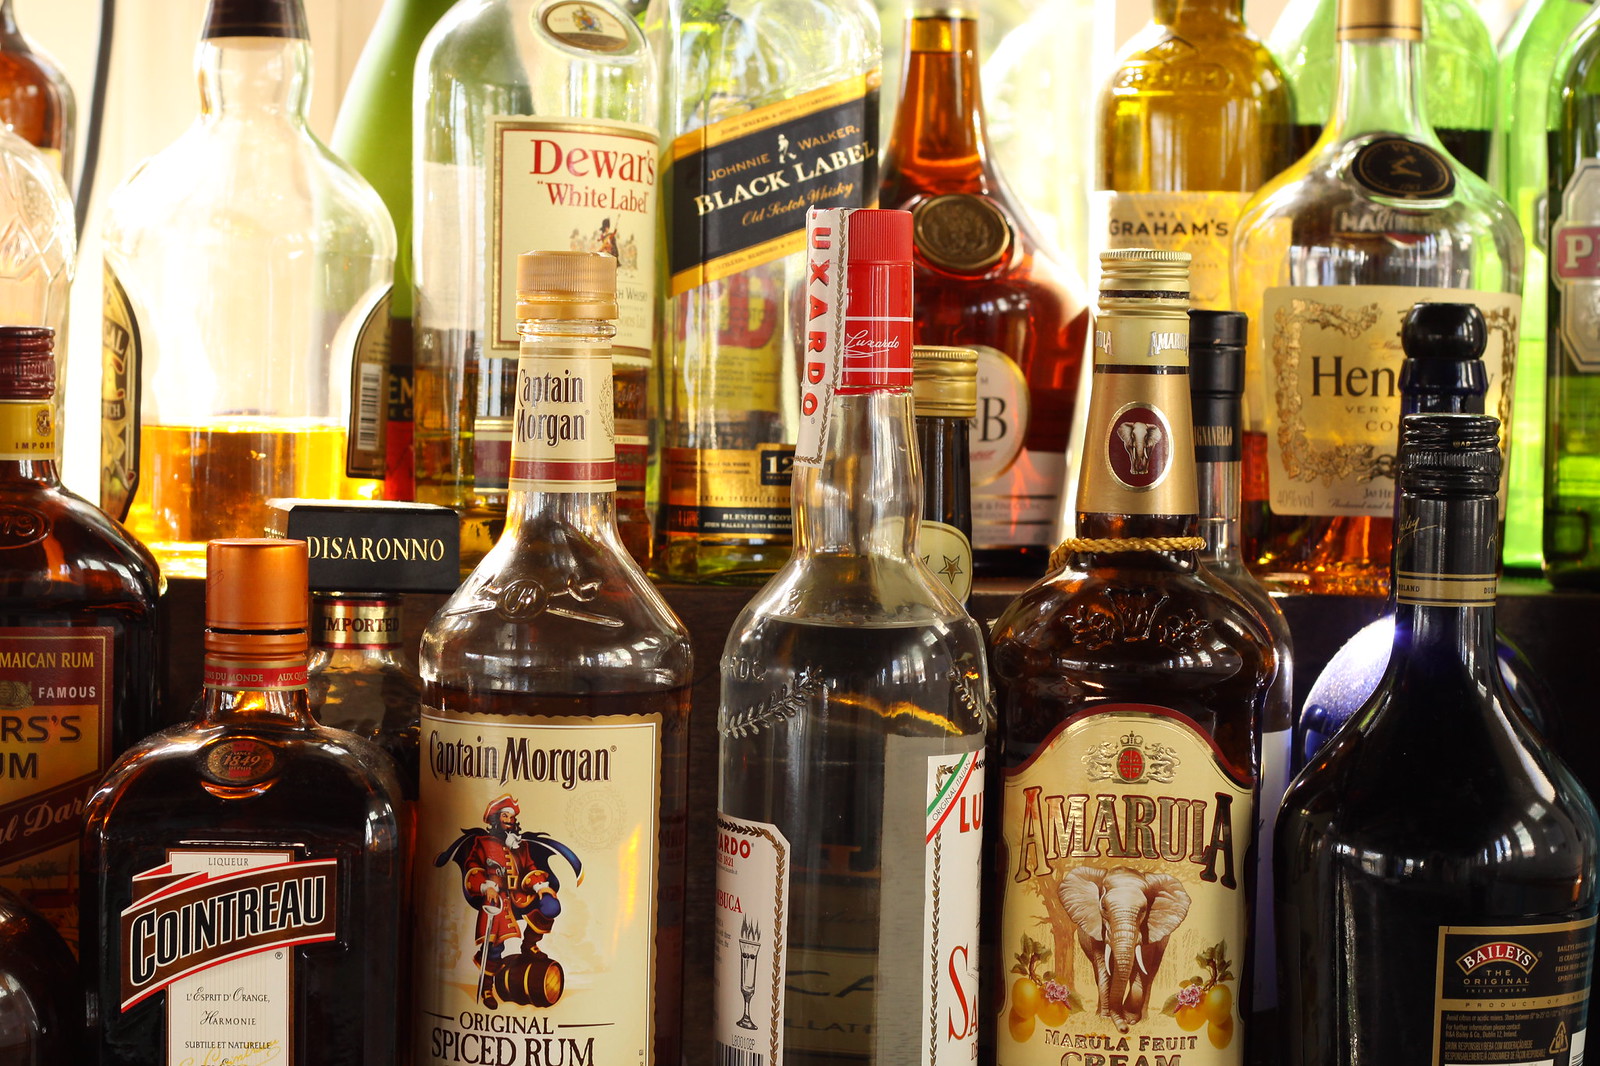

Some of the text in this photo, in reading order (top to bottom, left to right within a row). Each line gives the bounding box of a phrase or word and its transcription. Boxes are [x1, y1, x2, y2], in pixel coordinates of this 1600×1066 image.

[529, 139, 655, 186] Dewar's
[707, 153, 772, 182] JOHNNIE
[693, 141, 876, 216] BLACK LABEL
[741, 181, 854, 227] Old Scotch Whisky
[1110, 218, 1229, 238] GRAHAM'S
[803, 214, 831, 417] UXARDO
[845, 329, 900, 350] Luxardo
[518, 368, 585, 408] Captain
[1345, 405, 1390, 414] VERY
[15, 442, 56, 450] IMPORT
[722, 513, 793, 522] BLENDED SCOT
[306, 536, 445, 563] DISARONNO
[323, 616, 400, 633] IMPORTED
[0, 652, 94, 669] MAICAN RUM
[228, 673, 264, 683] MONDE
[277, 672, 295, 681] AUX
[38, 686, 96, 699] FAMOUS
[0, 715, 82, 743] RS'S
[223, 754, 261, 767] 1849
[429, 730, 611, 790] Captain Morgan
[932, 787, 957, 822] ORIGINAL
[955, 758, 972, 788] ITALIAN
[718, 834, 752, 859] ARDO
[1014, 786, 1237, 890] AMARULA
[207, 857, 250, 867] LIQUEUR
[718, 892, 743, 914] BUCA
[130, 875, 327, 987] COINTREAU
[1462, 945, 1533, 970] BAILEYS
[1463, 977, 1530, 985] ORIGINAL
[1486, 969, 1512, 977] THE
[200, 1010, 257, 1026] HARMONIE
[459, 1011, 554, 1035] ORIGINAL
[185, 1040, 271, 1050] SUBTILE ET NATURELLE
[431, 1027, 596, 1066] SPICED RUM
[1045, 1028, 1199, 1052] MARULA FRUIT
